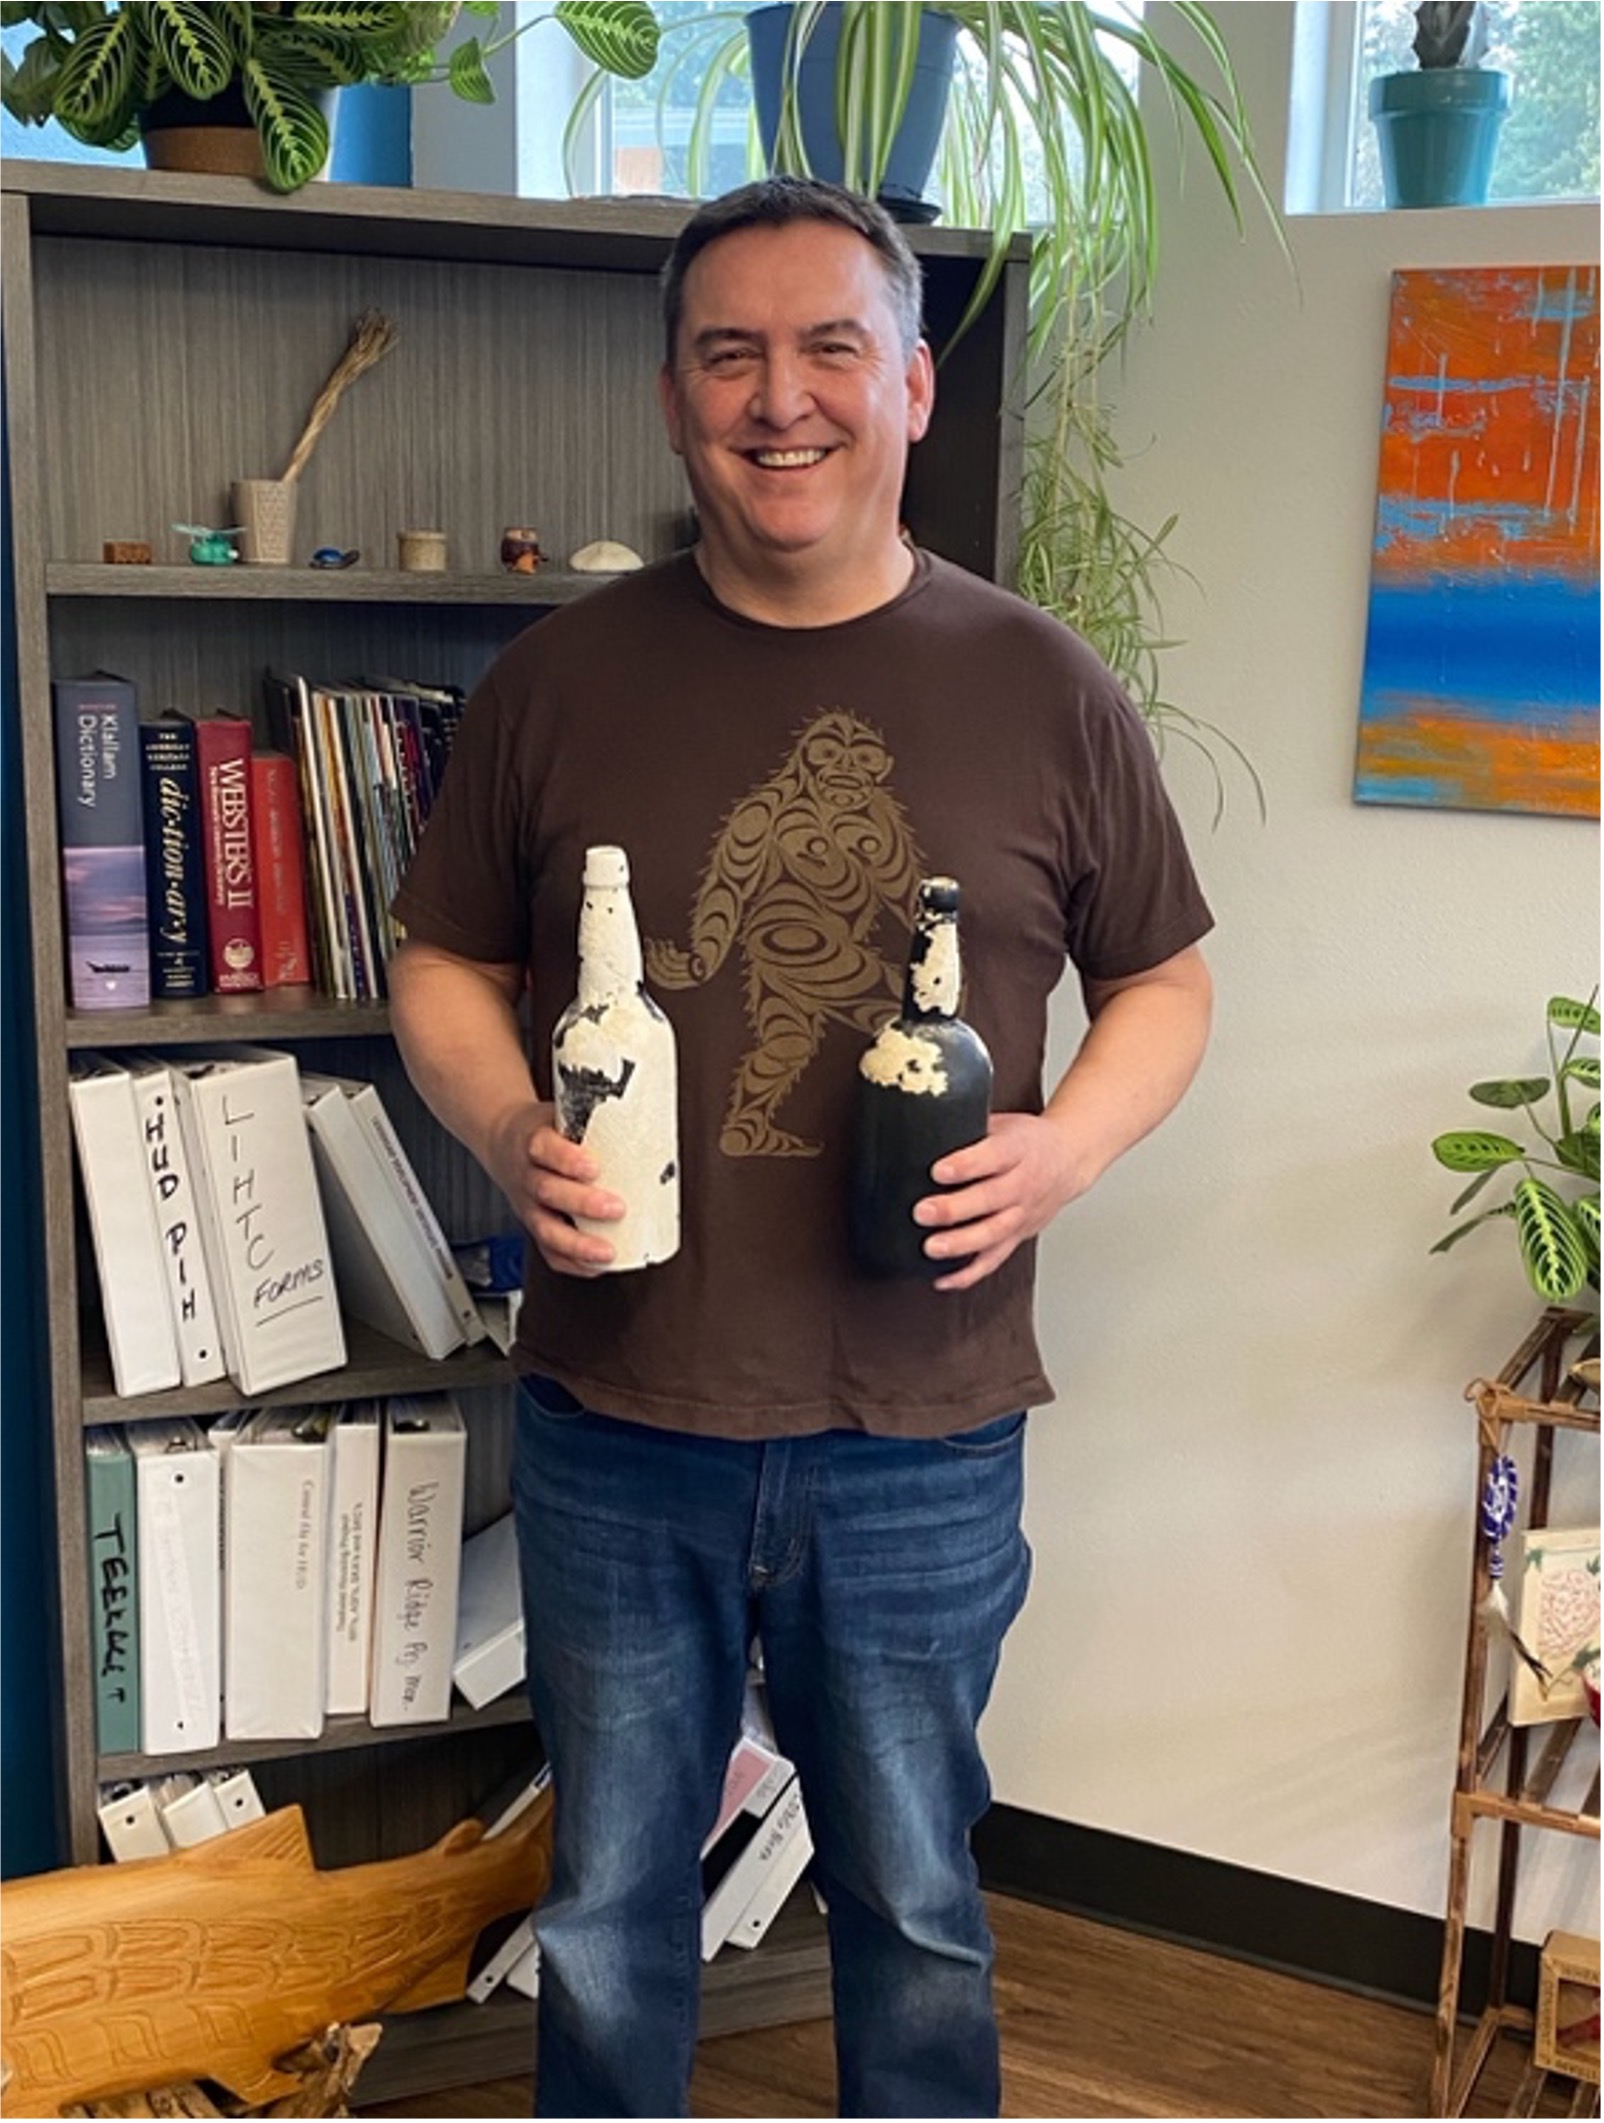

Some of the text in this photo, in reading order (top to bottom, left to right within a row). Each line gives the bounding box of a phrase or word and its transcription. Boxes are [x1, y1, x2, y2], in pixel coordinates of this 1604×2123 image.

[78, 714, 97, 807] Dictionary
[101, 713, 118, 779] Klallam
[145, 1113, 196, 1323] HUD PIH
[222, 1096, 276, 1271] LIHTC
[254, 1258, 324, 1308] FORMS
[407, 1481, 440, 1563] Warrior
[397, 1579, 434, 1630] Ridge
